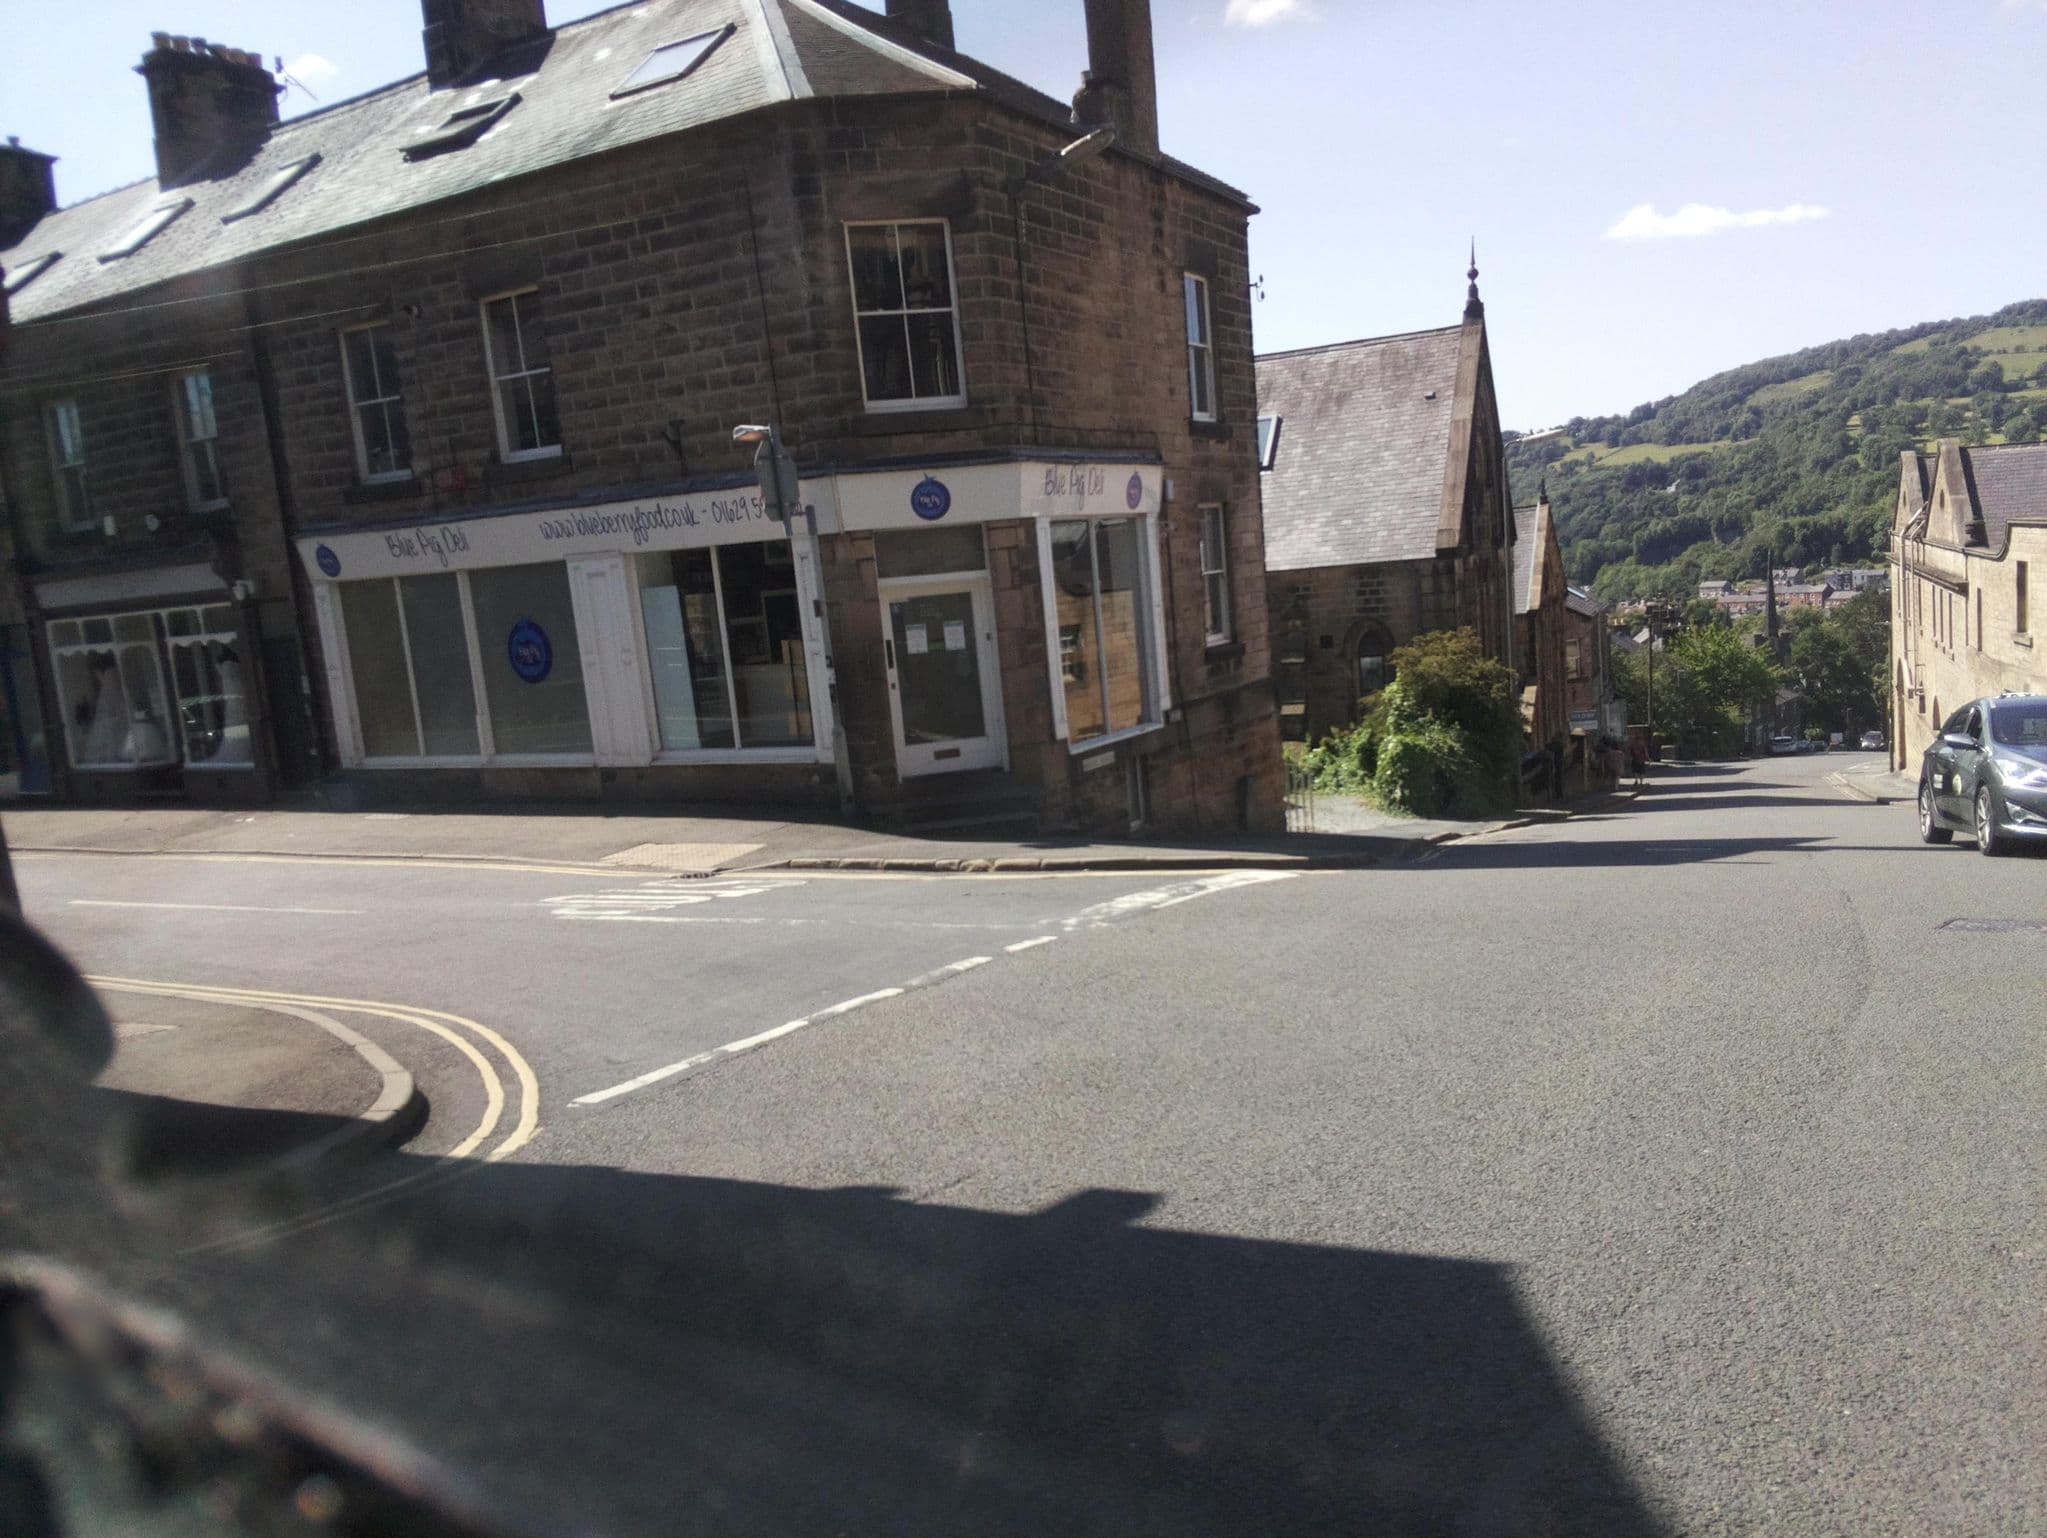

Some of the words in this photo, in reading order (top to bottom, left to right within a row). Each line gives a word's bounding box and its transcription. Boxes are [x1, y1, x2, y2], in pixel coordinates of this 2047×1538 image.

[711, 496, 752, 523] 01629
[1044, 464, 1066, 496] Blue
[1068, 464, 1085, 511] Pig
[1087, 467, 1104, 496] Deli
[384, 531, 419, 558] Blue
[415, 527, 448, 569] Pig
[440, 525, 470, 553] Deli
